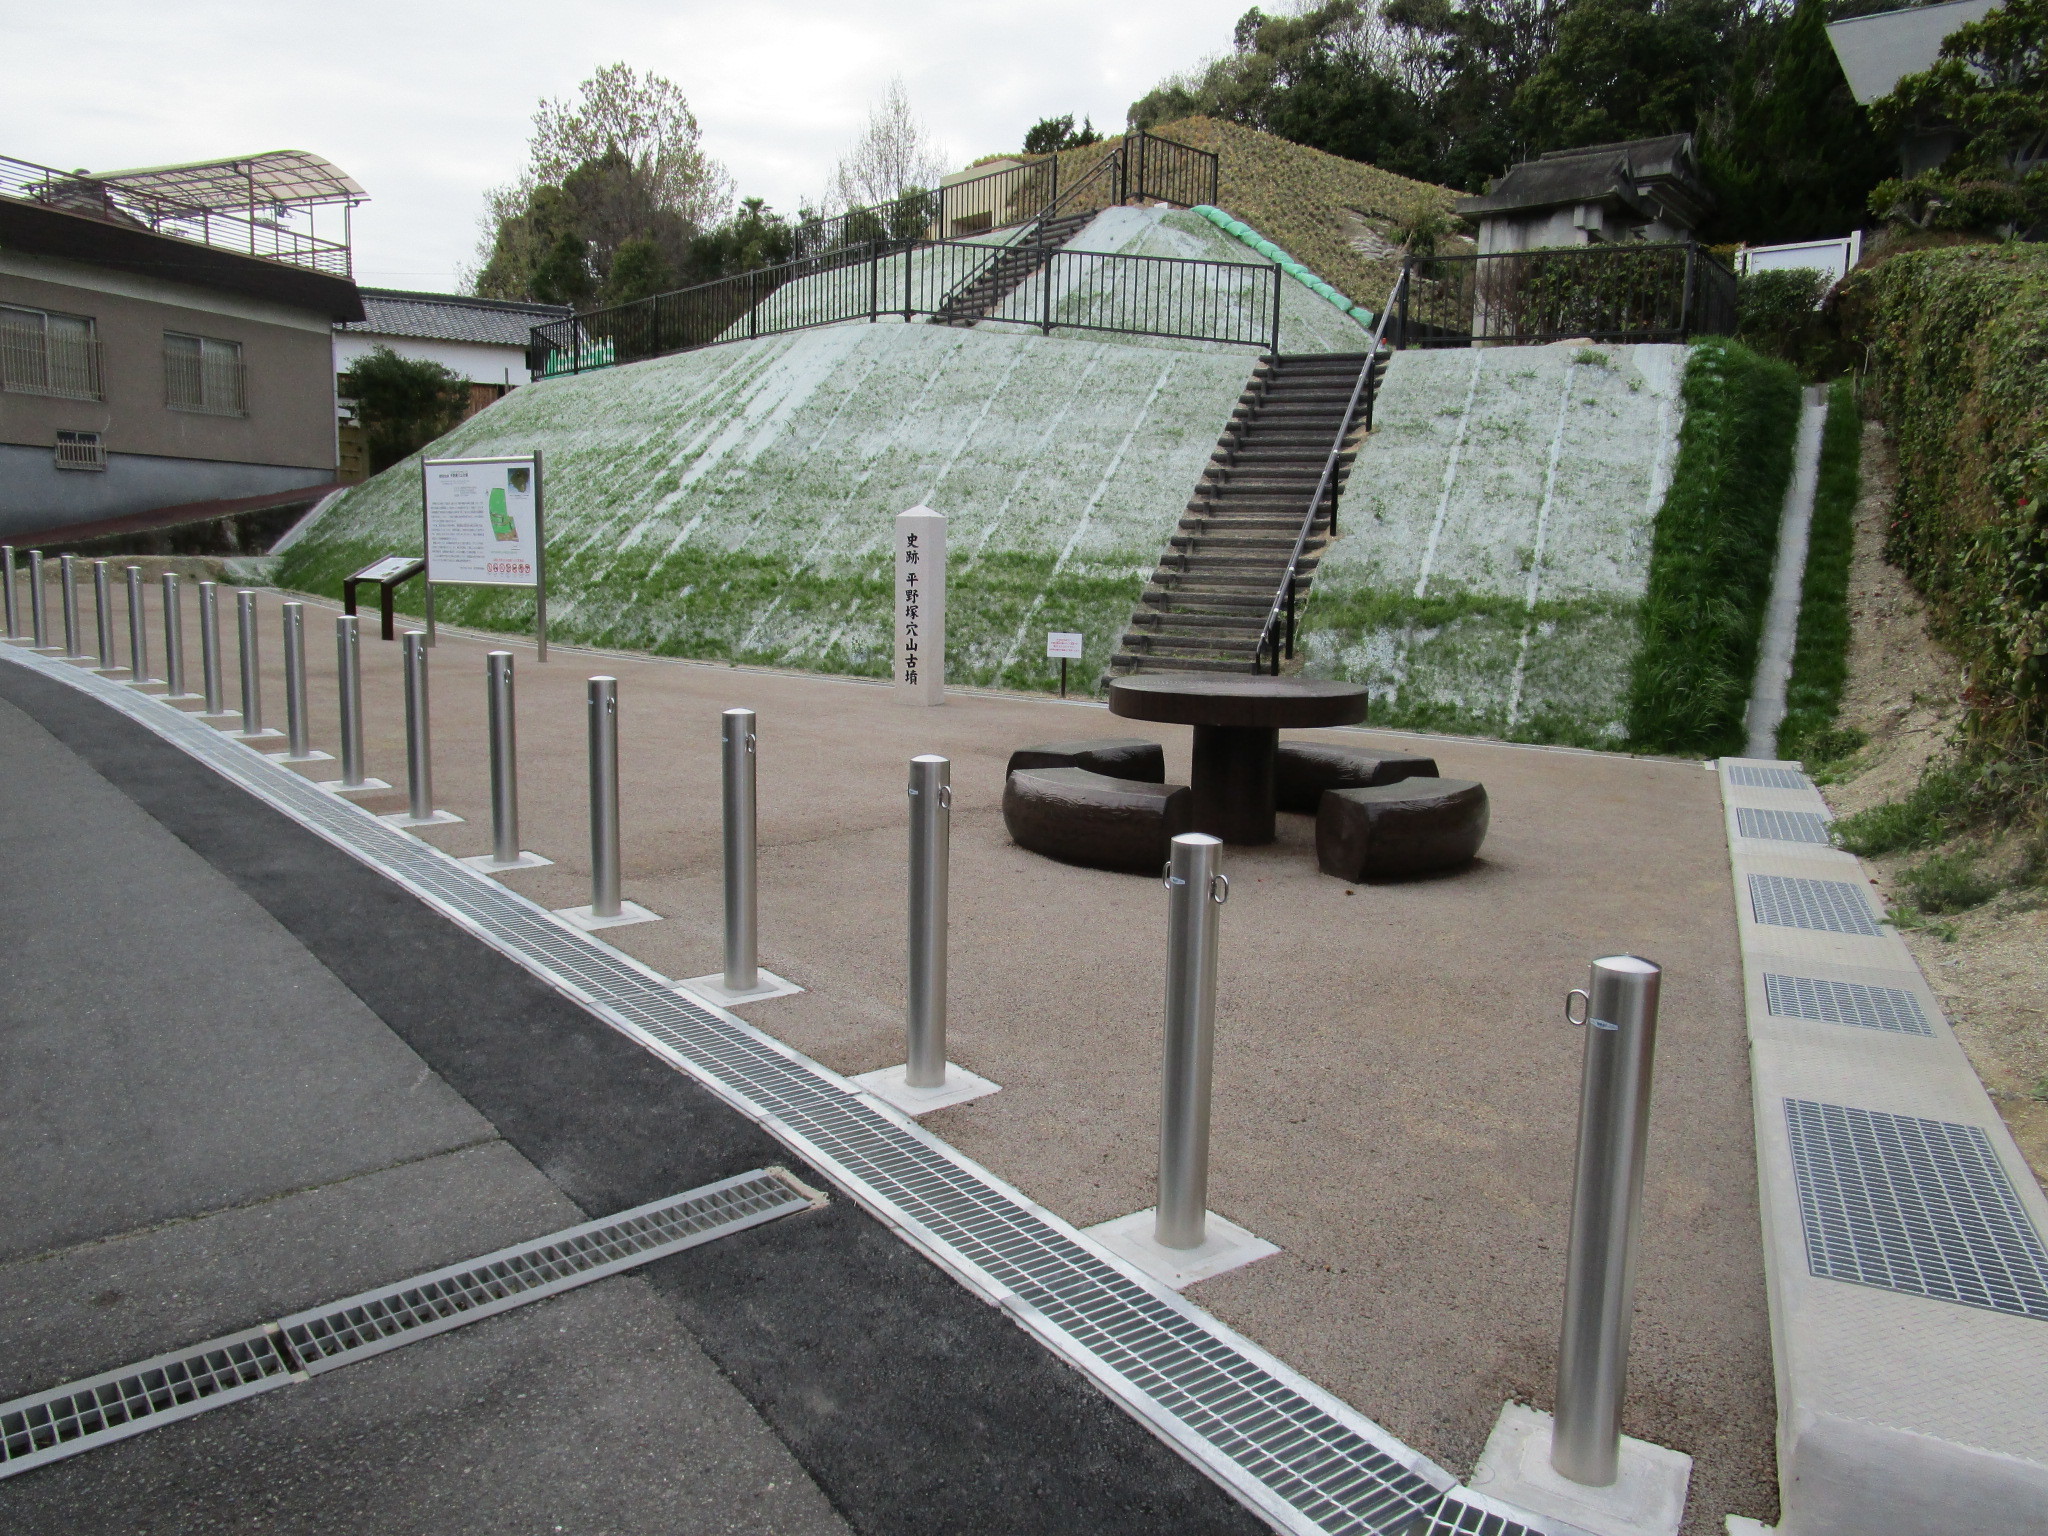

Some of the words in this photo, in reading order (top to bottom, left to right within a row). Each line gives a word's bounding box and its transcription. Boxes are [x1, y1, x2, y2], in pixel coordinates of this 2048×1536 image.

[906, 533, 920, 564] 史跡
[905, 573, 919, 685] 平野塚穴山古墳
